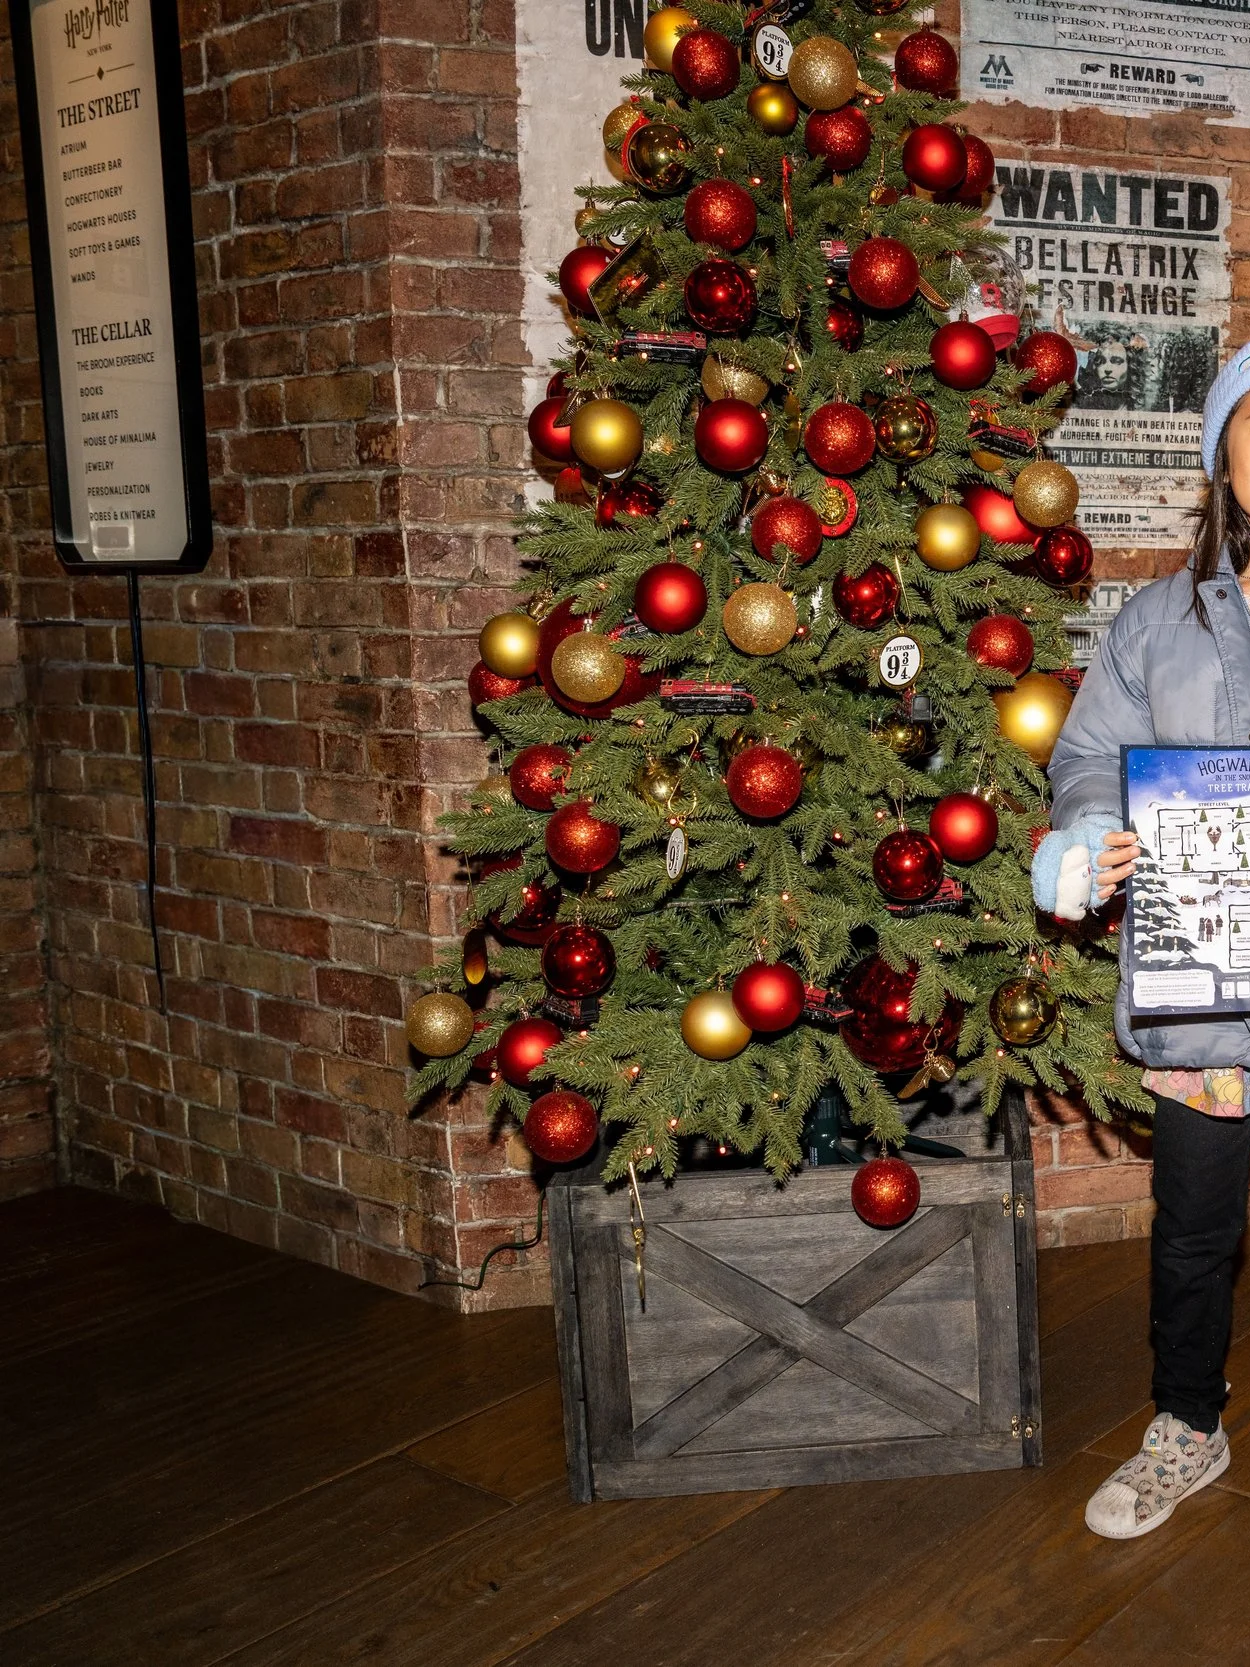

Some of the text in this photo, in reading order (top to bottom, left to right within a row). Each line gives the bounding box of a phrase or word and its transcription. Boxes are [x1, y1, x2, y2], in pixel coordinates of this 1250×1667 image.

[1036, 0, 1074, 10] HAVE
[1078, 4, 1110, 14] ANY
[1112, 8, 1205, 24] INFORMATION
[64, 0, 129, 49] Harry Potter
[1015, 12, 1049, 22] THIS
[1113, 23, 1166, 35] PLEASE
[1167, 29, 1227, 42] CONTACT
[762, 30, 790, 46] PLATFORM
[1057, 31, 1226, 56] NEAREST AUROR OFFICE.
[1109, 63, 1176, 85] REWARD
[58, 88, 141, 128] THE STREET
[60, 141, 87, 156] ATRIUM
[62, 159, 122, 181] BUTTERBEER BAR
[65, 185, 123, 207] CONFECTIONERY
[996, 166, 1219, 231] WANTED
[67, 210, 136, 233] HOGWARTS HOUSES
[69, 236, 140, 258] SOFT TOYS & GAMES
[1015, 235, 1199, 281] BELLATRIX
[71, 270, 95, 283] WANDS
[72, 318, 152, 346] THE CELLAR
[77, 352, 154, 371] THE BROOM EXPERIENCE
[80, 386, 103, 397] BOOKS
[82, 410, 119, 422] DARK ARTS
[84, 432, 156, 446] HOUSE OF MINALIMA
[86, 460, 114, 474] JEWELRY
[1071, 451, 1201, 467] WITH EXTREME CAUTION!
[88, 484, 150, 496] PERSONALIZATION
[89, 509, 156, 521] ROBES & KNITWEAR
[1084, 513, 1131, 524] REWARD
[1208, 784, 1233, 793] TREE
